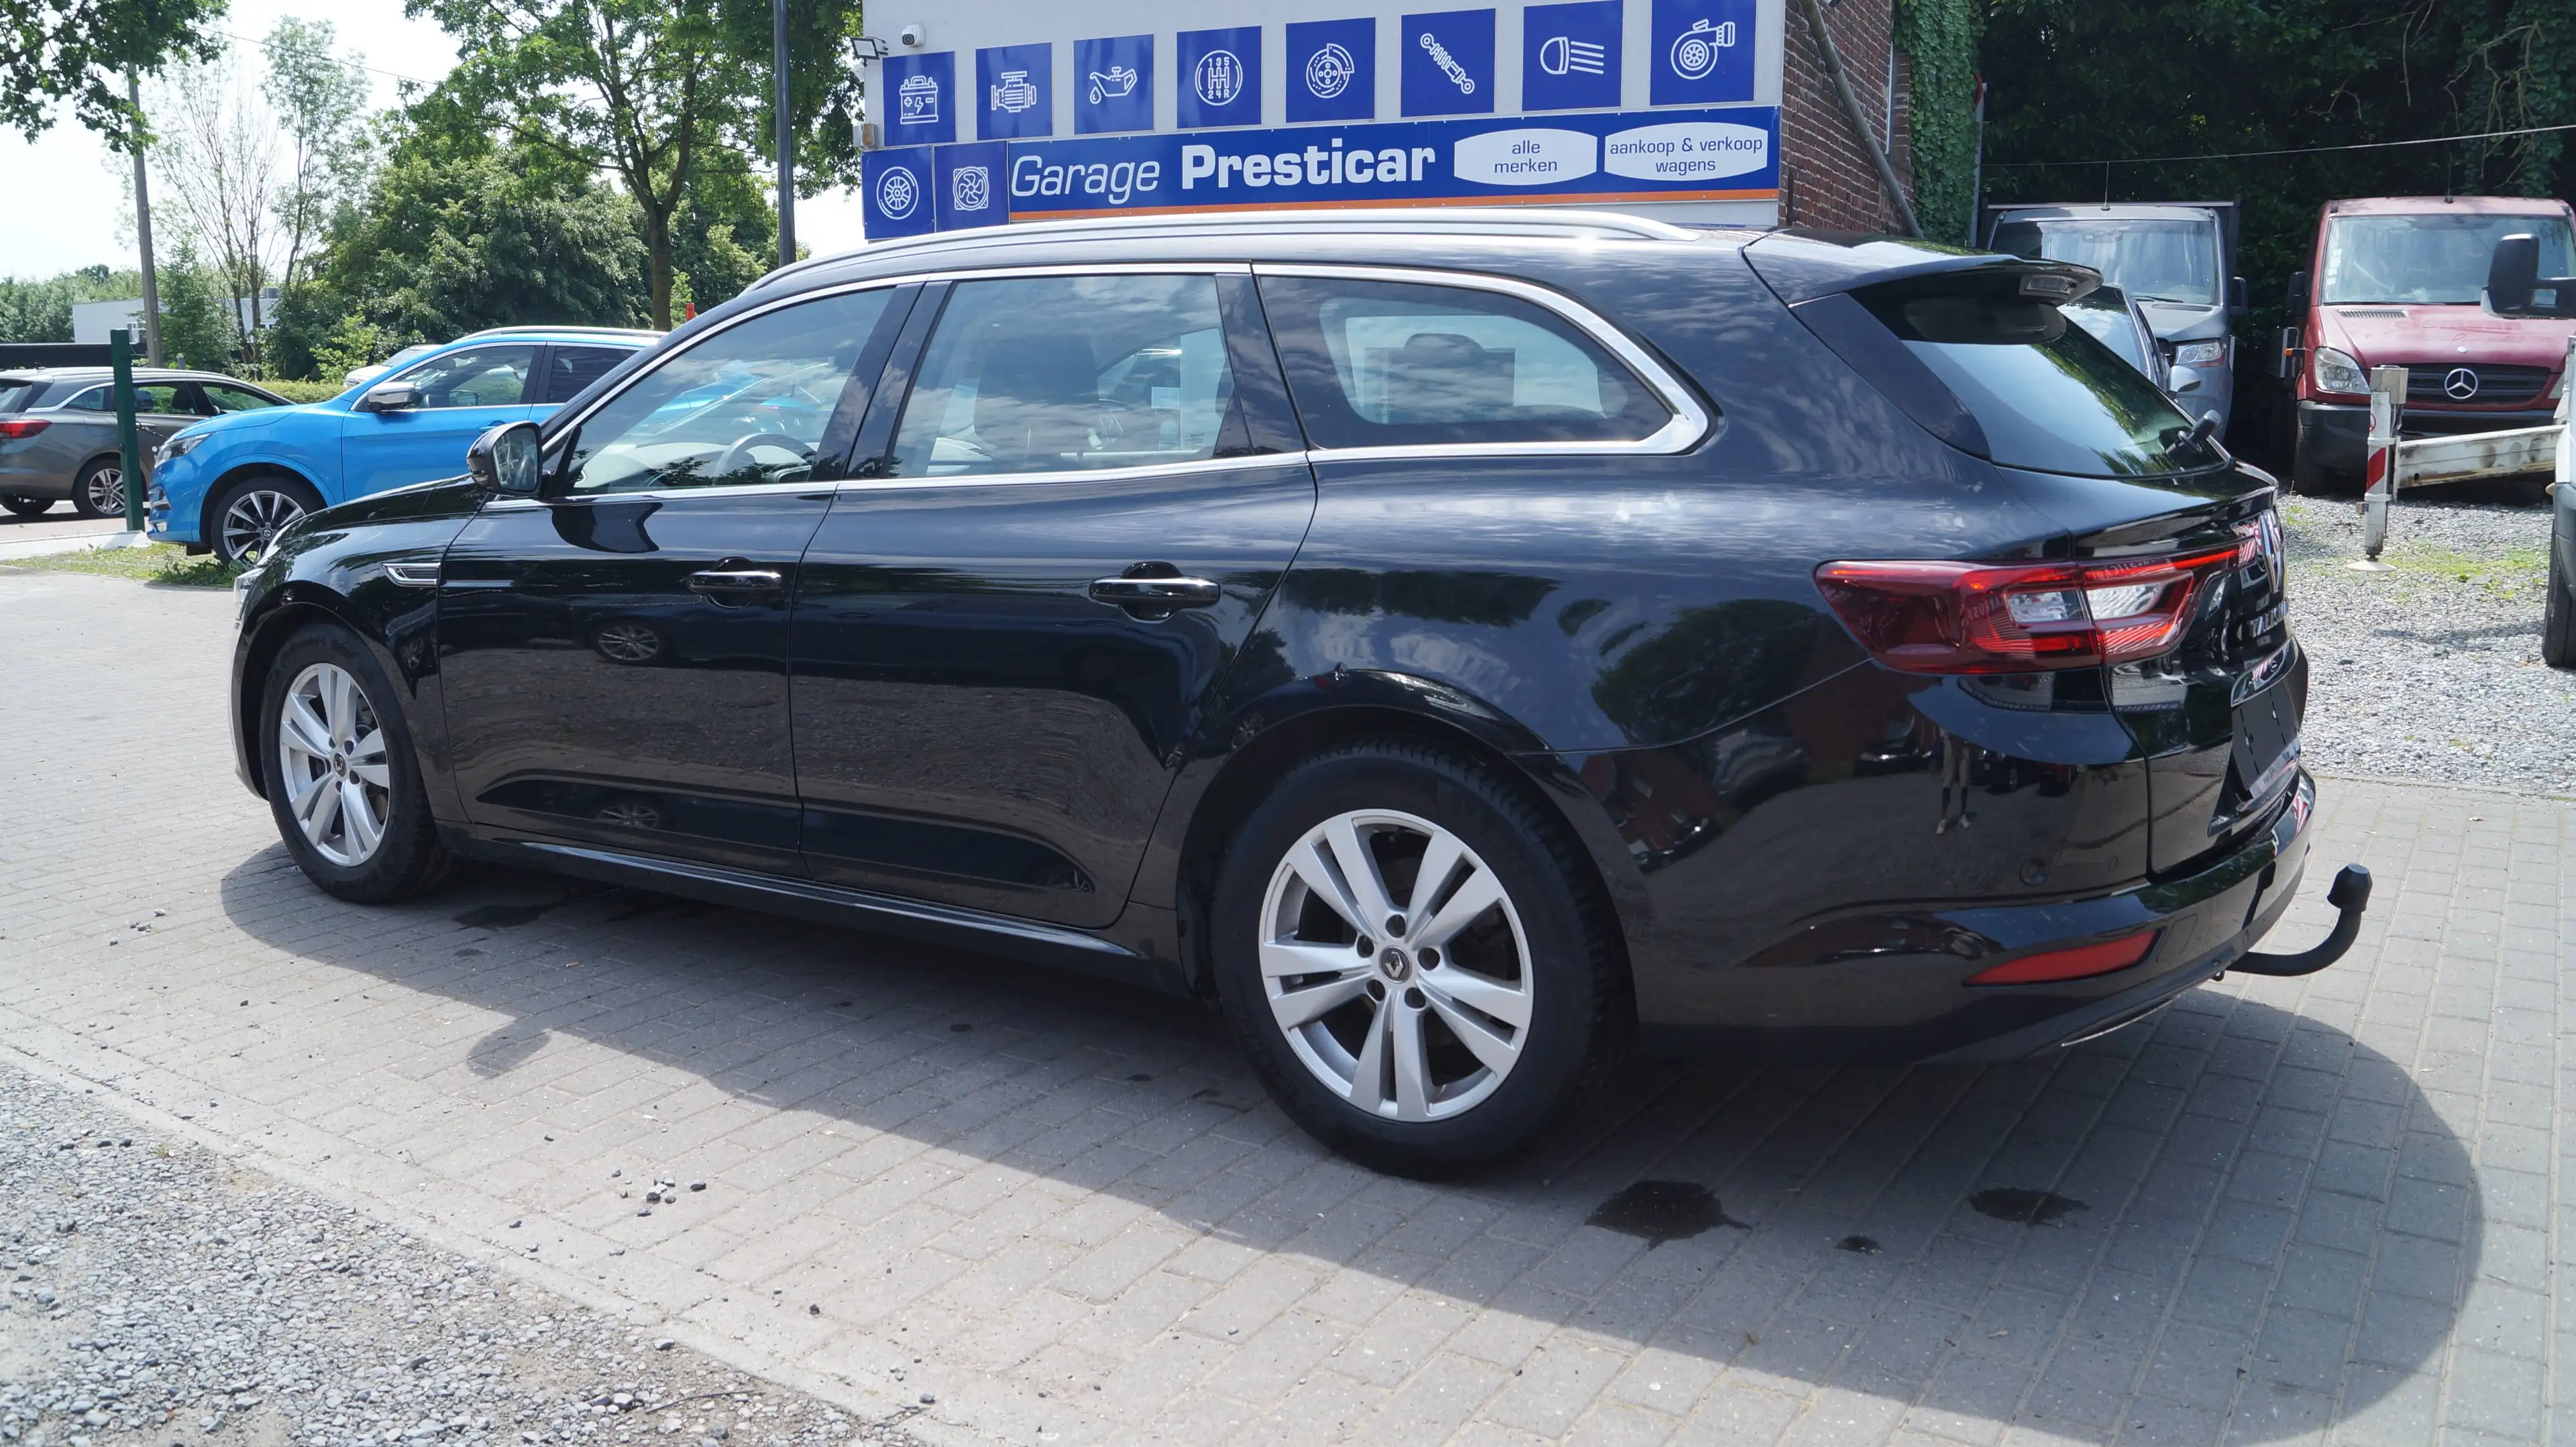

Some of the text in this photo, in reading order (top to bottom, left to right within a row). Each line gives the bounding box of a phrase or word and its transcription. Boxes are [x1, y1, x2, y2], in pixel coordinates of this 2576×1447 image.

[1511, 140, 1540, 154] alle
[1609, 136, 1763, 156] aankoop & verkoop
[1011, 138, 1436, 205] Garage Presticar
[1494, 158, 1557, 173] merken
[1655, 160, 1716, 176] wagens
[2247, 597, 2289, 638] TALIS
